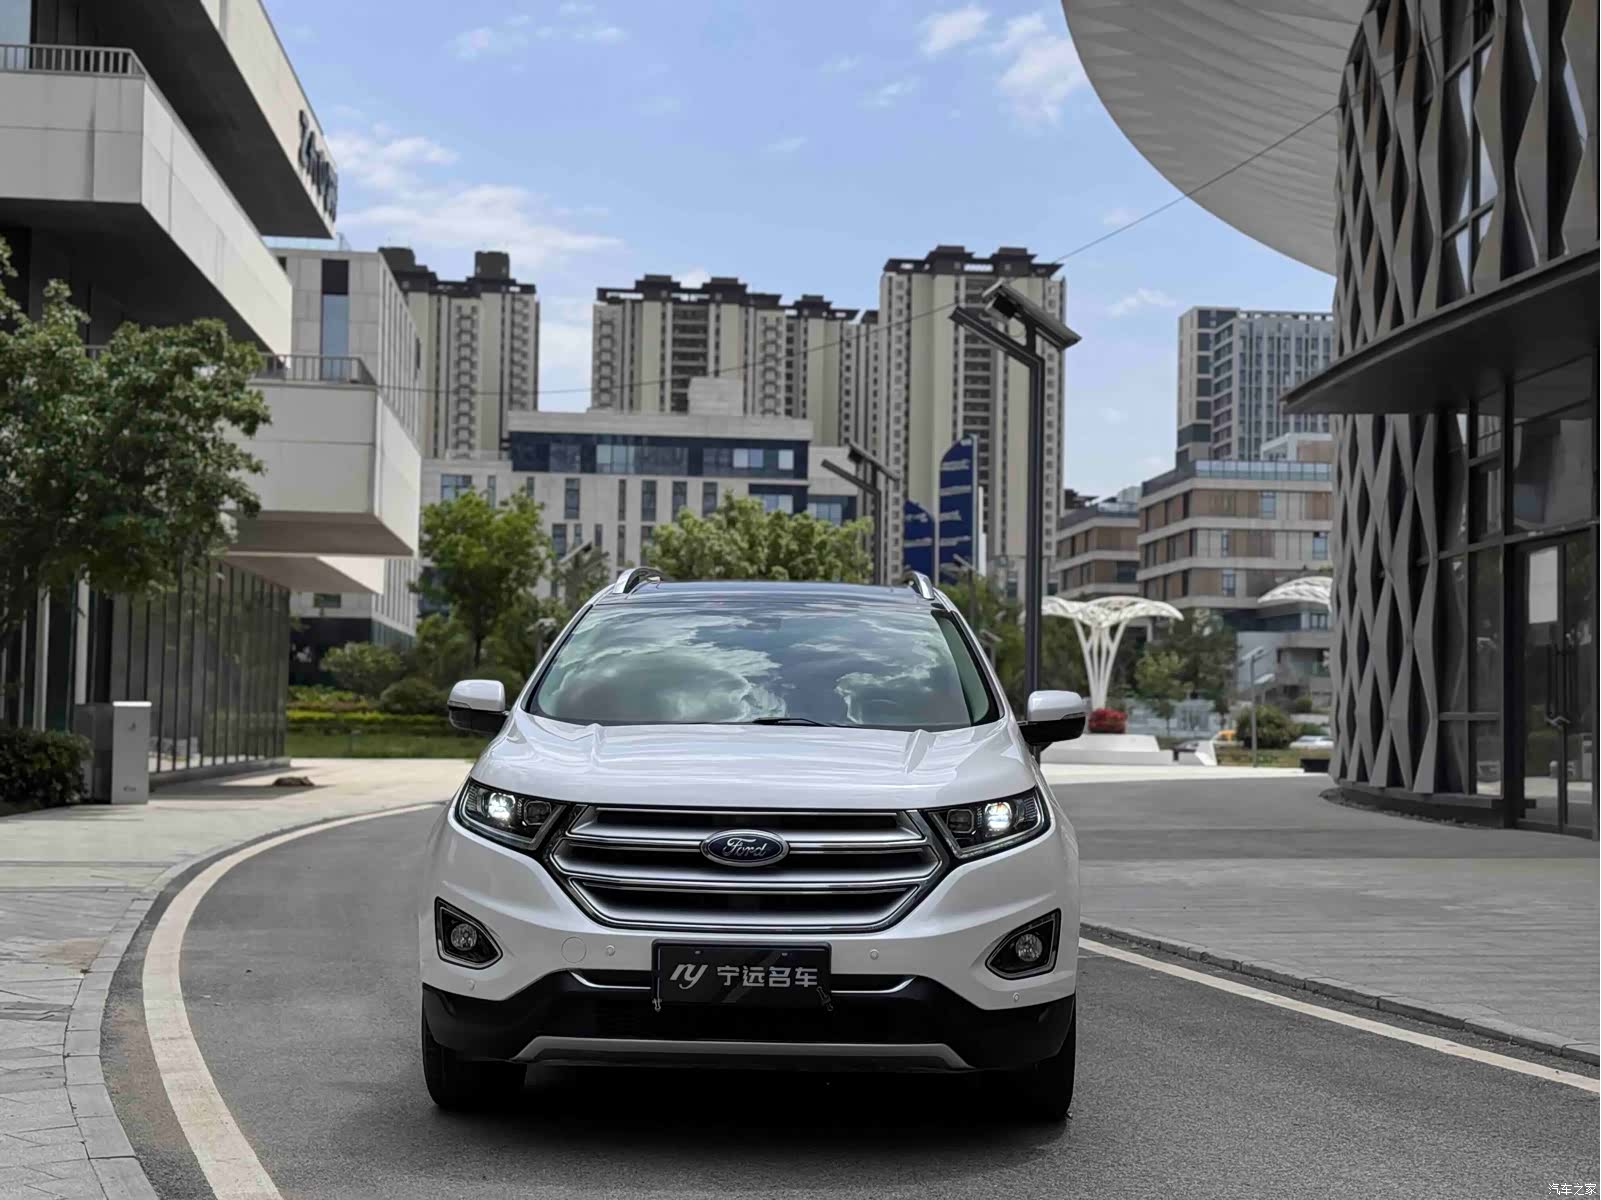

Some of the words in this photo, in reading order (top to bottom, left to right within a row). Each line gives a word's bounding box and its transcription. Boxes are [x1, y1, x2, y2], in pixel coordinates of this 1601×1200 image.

[722, 837, 767, 857] Ford
[717, 965, 818, 988] 宁远名车
